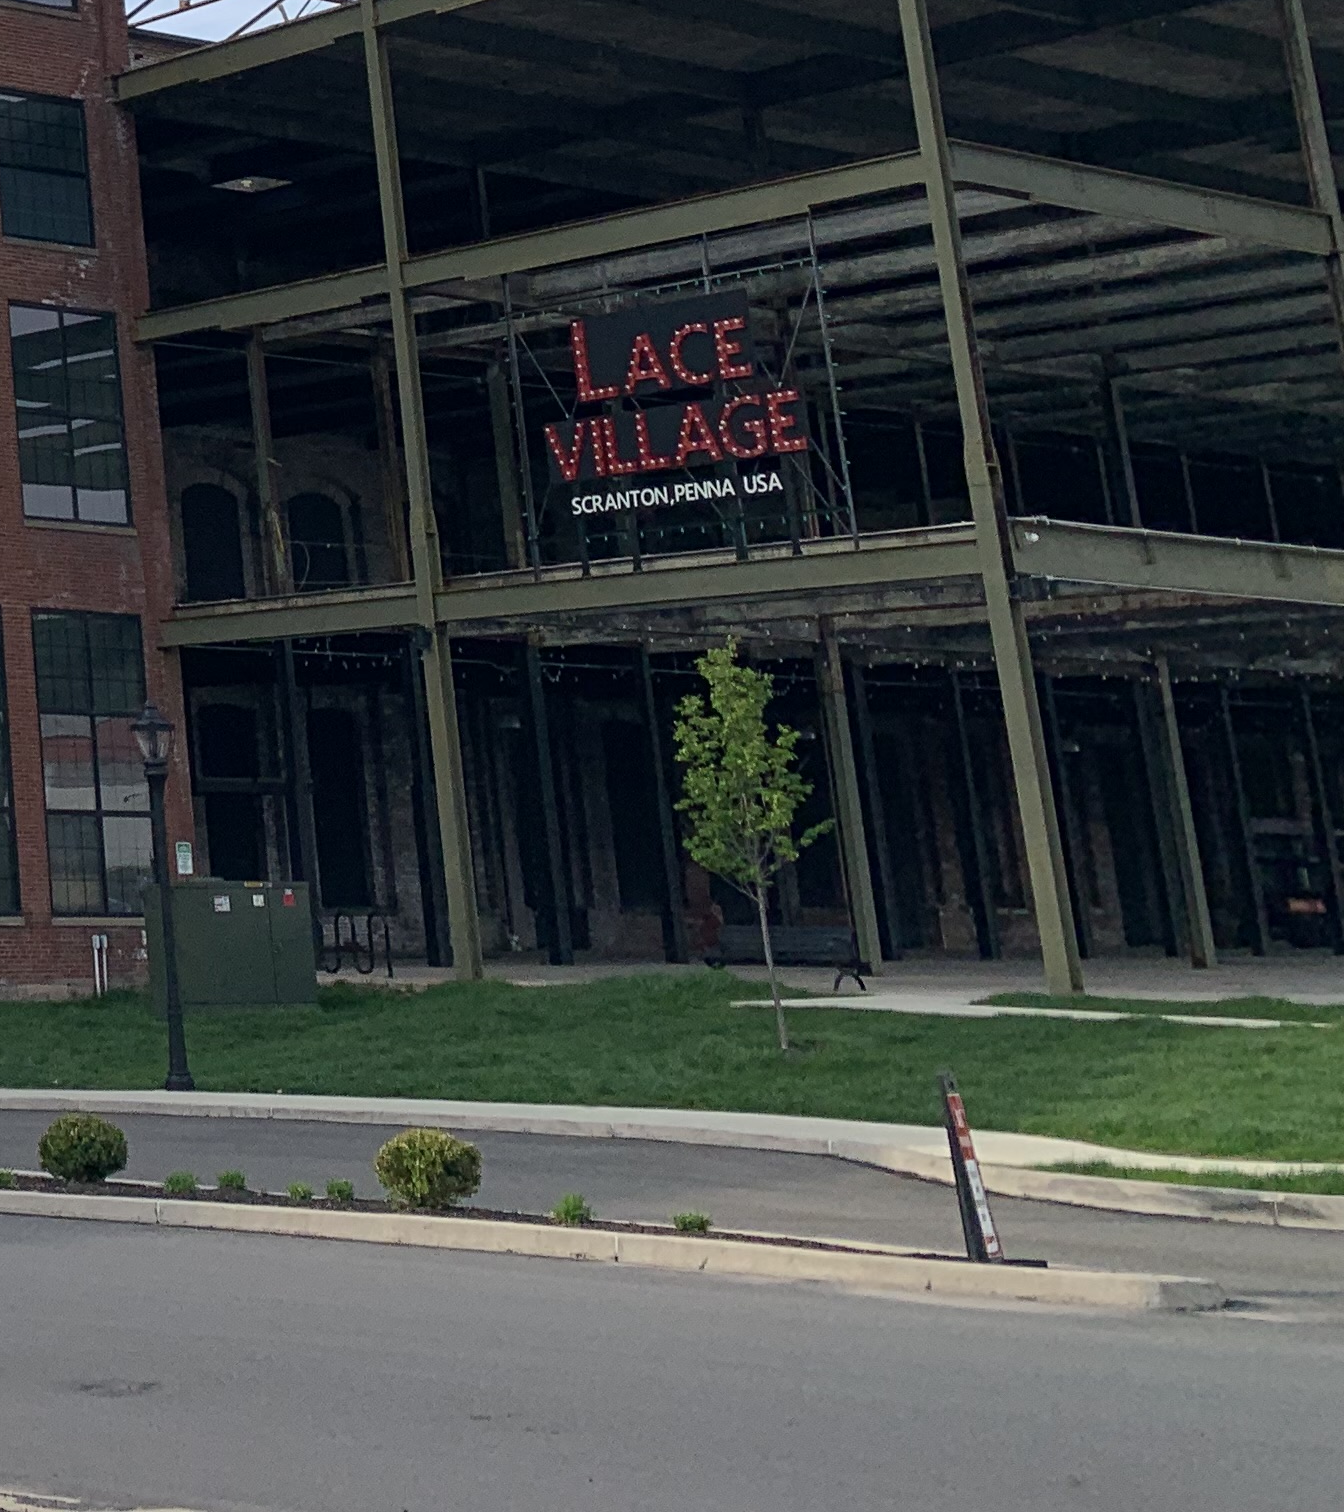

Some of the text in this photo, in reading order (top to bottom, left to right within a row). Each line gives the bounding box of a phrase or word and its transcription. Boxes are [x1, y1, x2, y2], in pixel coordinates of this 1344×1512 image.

[570, 316, 753, 402] LACE
[544, 388, 808, 481] VILLAGE
[743, 472, 783, 494] USA
